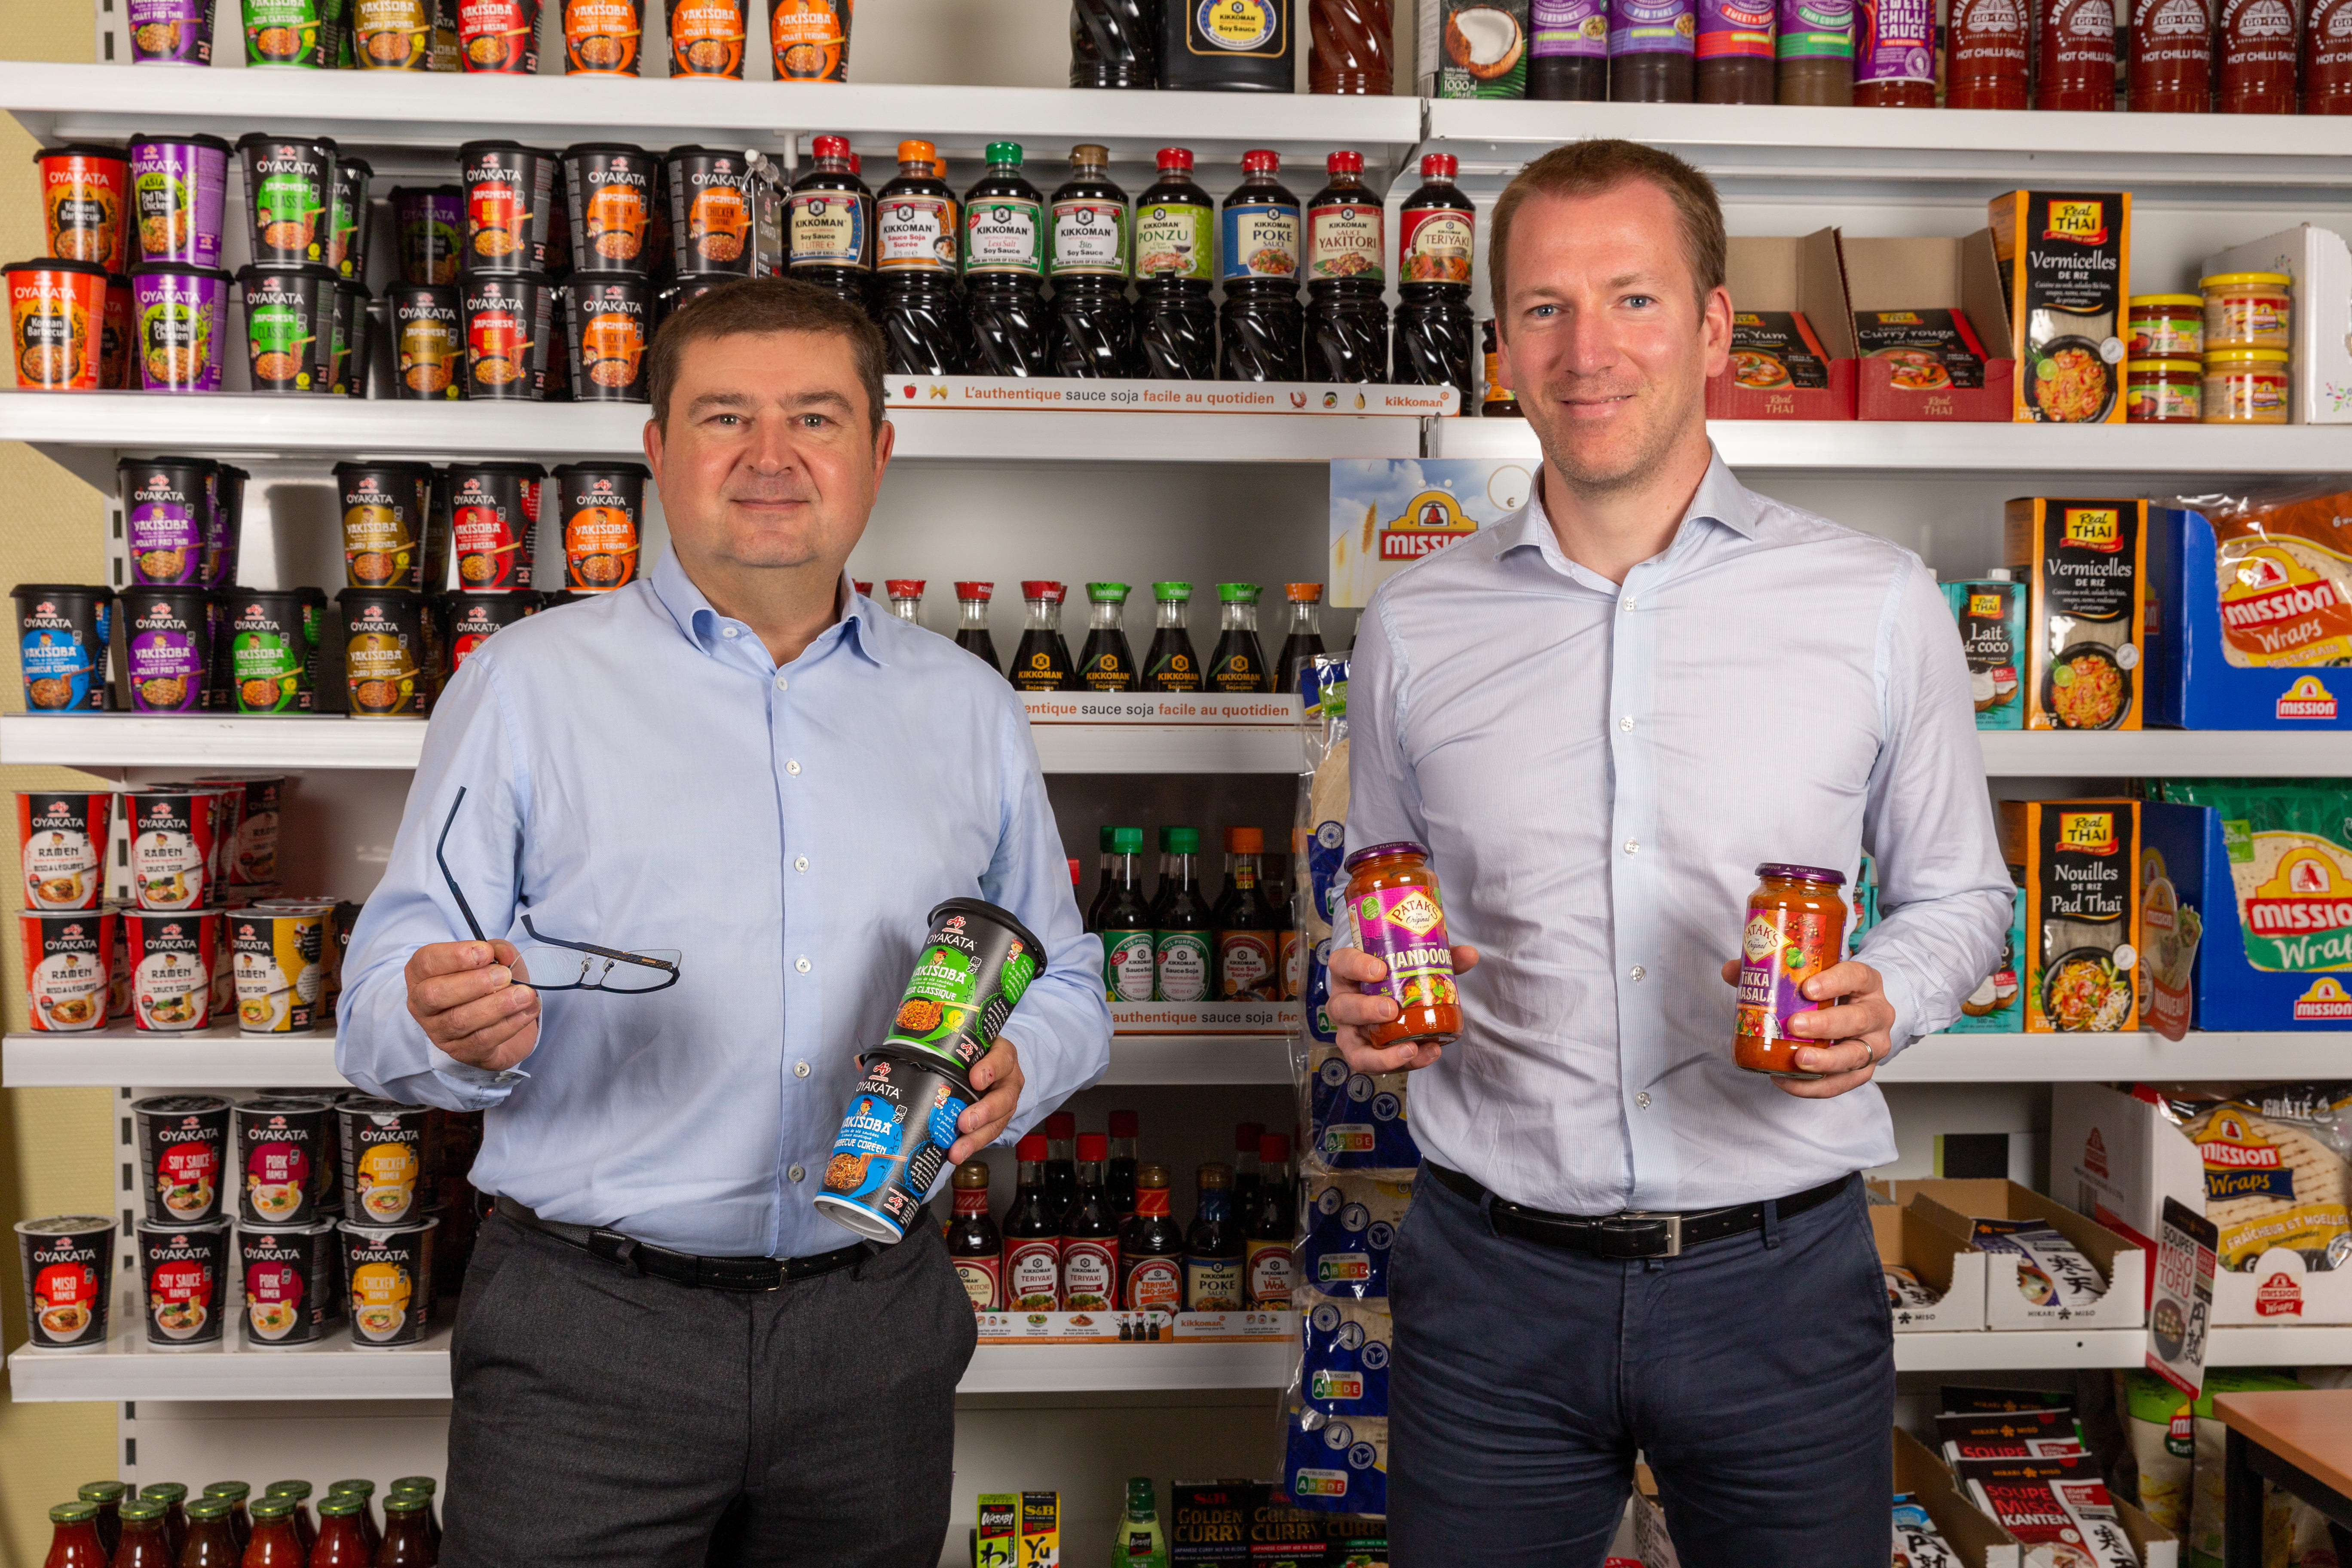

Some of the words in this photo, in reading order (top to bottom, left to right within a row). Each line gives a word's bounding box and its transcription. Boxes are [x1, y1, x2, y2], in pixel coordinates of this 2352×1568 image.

[1879, 11, 1926, 23] CHILLI
[1219, 25, 1232, 33] Soy
[1879, 25, 1926, 39] SAUCE
[1957, 49, 1973, 60] HOT
[1974, 48, 2003, 59] CHILLI
[2058, 51, 2073, 62] HOT
[2075, 51, 2105, 61] CHILLI
[2142, 52, 2159, 63] HOT
[2160, 50, 2190, 62] CHILLI
[2228, 54, 2244, 65] HOT
[2246, 52, 2277, 64] CHILLI
[257, 161, 318, 175] OYAKATA
[467, 169, 522, 182] OYAKATA
[588, 172, 645, 186] OYAKATA
[2063, 205, 2092, 216] Real
[796, 218, 844, 228] KIKKOMAN
[883, 224, 933, 233] KIKKOMAN
[2056, 217, 2096, 230] THAI
[977, 226, 1028, 236] KIKKOMAN
[1061, 227, 1111, 237] KIKKOMAN
[1139, 229, 1188, 243] PONZU
[1253, 230, 1292, 242] POKE
[1320, 236, 1376, 249] YAKITORI
[1424, 234, 1470, 247] TERIYAKI
[2030, 250, 2117, 270] Vermicelles
[2073, 271, 2089, 279] RIZ
[15, 286, 77, 300] OYAKATA
[467, 298, 523, 310] OYAKATA
[584, 300, 641, 313] OYAKATA
[399, 308, 455, 320] OYAKATA
[31, 317, 62, 328] Korean
[1859, 329, 1906, 342] Curry
[1911, 330, 1955, 342] rouge
[965, 386, 1061, 402] L'authentique
[1066, 391, 1106, 401] sauce
[1111, 389, 1139, 404] soja
[1144, 390, 1181, 402] facile
[1185, 392, 1202, 403] au
[1207, 391, 1274, 407] quotidien
[1385, 396, 1442, 407] kikkoman
[1765, 404, 1794, 414] THAI
[1923, 405, 1953, 416] THAI
[577, 496, 625, 506] OYAKATA
[1507, 497, 1515, 507] €
[134, 519, 188, 531] YAKISOBA
[2079, 513, 2108, 525] Real
[347, 522, 397, 534] YAKISOBA
[455, 523, 501, 535] YAKISOBA
[575, 524, 628, 536] YAKISOBA
[2072, 525, 2111, 538] THAI
[2047, 557, 2132, 577] Vermicelles
[2076, 579, 2087, 587] DE
[2091, 579, 2105, 587] RIZ
[1974, 603, 1997, 611] THAI
[1971, 623, 2003, 641] Lait
[2256, 618, 2322, 653] Wraps
[24, 646, 76, 659] YAKISOBA
[135, 646, 190, 659] YAKISOBA
[350, 649, 402, 662] YAKISOBA
[1018, 671, 1062, 680] KIKKOMAN
[1087, 672, 1129, 680] KIKKOMAN
[1158, 672, 1199, 681] KIKKOMAN
[1217, 673, 1260, 681] KIKKOMAN
[1082, 705, 1121, 715] sauce
[1127, 703, 1154, 717] soja
[1159, 703, 1195, 715] facile
[1201, 706, 1217, 715] au
[1222, 704, 1289, 718] quotidien
[2075, 816, 2102, 828] Real
[2068, 828, 2107, 842] THAI
[38, 847, 79, 857] RAMEN
[145, 848, 183, 858] RAMEN
[1358, 846, 1378, 855] UNLOCK
[2055, 861, 2119, 882] Nouilles
[2087, 882, 2102, 891] RIZ
[2051, 894, 2082, 913] Pad
[2085, 894, 2122, 912] Thaï
[1391, 900, 1438, 922] PATAK'S
[1406, 915, 1430, 925] Original
[1744, 924, 1780, 947] PATAK'S
[928, 933, 975, 952] OYAKATA
[1747, 940, 1767, 951] Original
[967, 956, 982, 974] 親方
[52, 968, 92, 980] RAMEN
[152, 968, 191, 979] RAMEN
[916, 986, 957, 1002] CLASSIQUE
[1737, 986, 1775, 1003] MASALA
[1202, 1013, 1241, 1023] sauce
[1246, 1012, 1273, 1025] soja
[856, 1081, 900, 1099] OYAKATA
[891, 1105, 907, 1124] 親方
[159, 1129, 218, 1142] OYAKATA
[361, 1130, 419, 1142] OYAKATA
[857, 1139, 887, 1155] CORÉEN
[169, 1155, 184, 1170] SOY
[186, 1153, 209, 1168] SAUCE
[266, 1155, 288, 1169] PORK
[373, 1157, 405, 1171] CHICKEN
[2206, 1173, 2270, 1195] Wraps
[34, 1249, 95, 1262] OYAKATA
[150, 1247, 210, 1259] OYAKATA
[244, 1247, 300, 1260] OYAKATA
[351, 1249, 409, 1261] OYAKATA
[52, 1276, 76, 1291] MISO
[159, 1274, 173, 1288] SOY
[176, 1272, 201, 1287] SAUCE
[259, 1274, 280, 1288] PORK
[363, 1276, 395, 1289] CHICKEN
[1199, 1280, 1235, 1290] POKE
[1263, 1280, 1286, 1289] Wok
[2159, 1263, 2191, 1298] TOFU
[2265, 1301, 2294, 1314] Wraps
[1985, 1485, 2049, 1501] SOUPE
[1024, 1505, 1055, 1516] S&B
[1994, 1499, 2064, 1515] MISO
[981, 1512, 1014, 1526] WASABI
[2002, 1514, 2072, 1526] KANTEN
